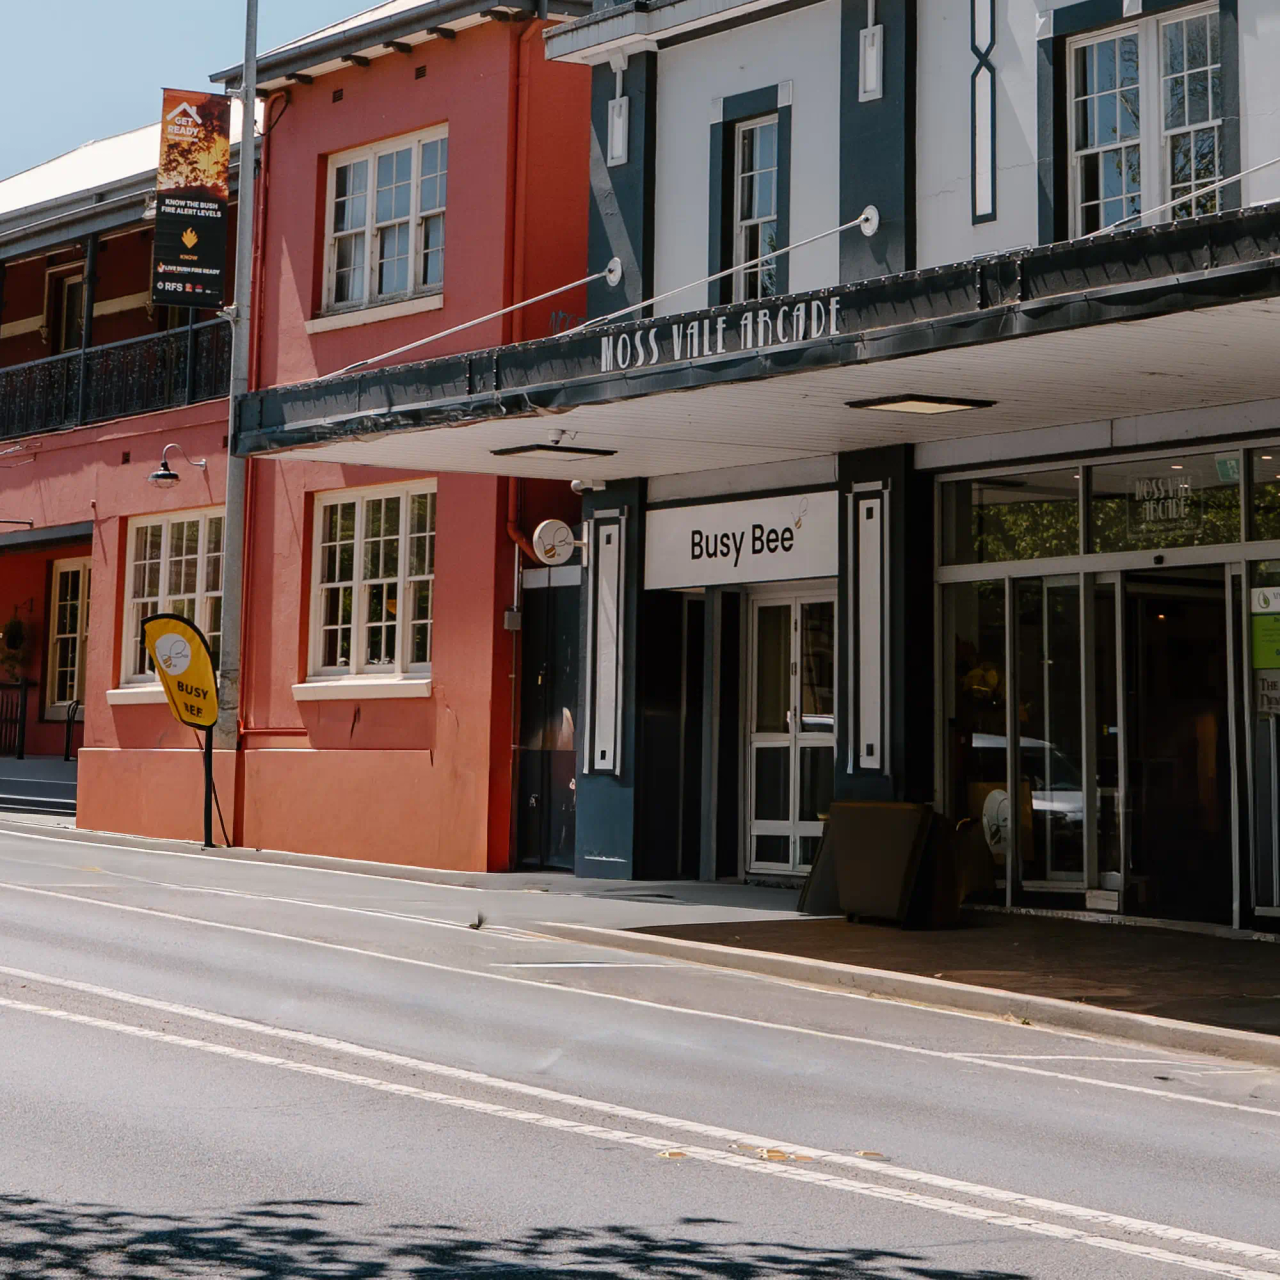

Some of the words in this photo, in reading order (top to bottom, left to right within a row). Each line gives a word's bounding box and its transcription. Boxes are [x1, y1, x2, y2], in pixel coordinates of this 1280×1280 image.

[175, 117, 193, 126] GET
[168, 126, 199, 136] READY
[161, 206, 176, 214] FIRE
[176, 206, 196, 215] ALERT
[198, 209, 222, 218] LEVELS
[165, 198, 186, 206] KNOW
[187, 200, 199, 208] THE
[200, 202, 218, 212] BUSH
[164, 282, 183, 292] RFS
[601, 327, 659, 372] MOSS
[672, 316, 726, 360] VALE
[741, 297, 840, 350] ARCADE
[1135, 478, 1165, 501] MOSS
[1168, 476, 1193, 498] VALE
[1142, 498, 1187, 520] ARCADE
[691, 530, 745, 568] Busy
[752, 524, 794, 554] Bee
[177, 681, 209, 700] BUSY
[1260, 678, 1278, 692] THE
